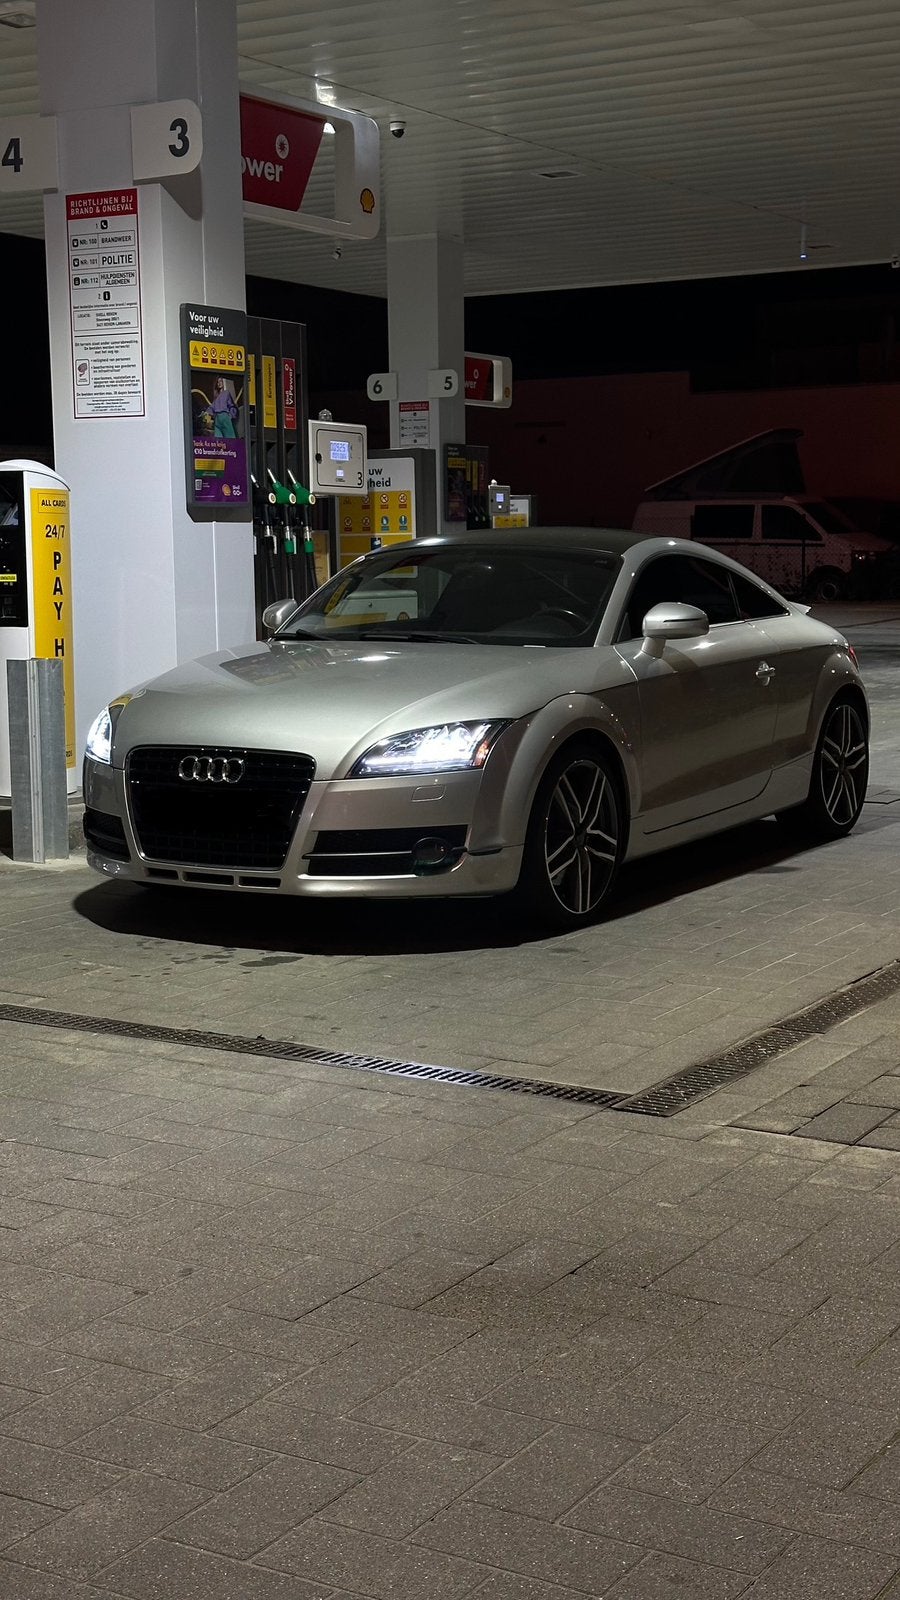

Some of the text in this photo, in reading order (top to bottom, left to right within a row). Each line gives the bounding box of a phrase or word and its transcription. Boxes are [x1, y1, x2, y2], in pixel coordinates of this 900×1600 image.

[168, 118, 190, 158] 3
[1, 138, 24, 173] 4
[70, 195, 133, 208] RICHTLIJNEN BIJ
[70, 206, 94, 216] BRAND
[102, 204, 133, 213] ONGEVAL
[102, 254, 132, 265] POLITIE
[189, 311, 206, 322] Voor
[190, 324, 224, 337] veiligheid
[372, 380, 383, 394] 6
[444, 376, 453, 390] 5
[368, 467, 383, 475] uw
[357, 472, 362, 485] 3
[45, 524, 65, 540] 24/7
[53, 551, 64, 620] PAY
